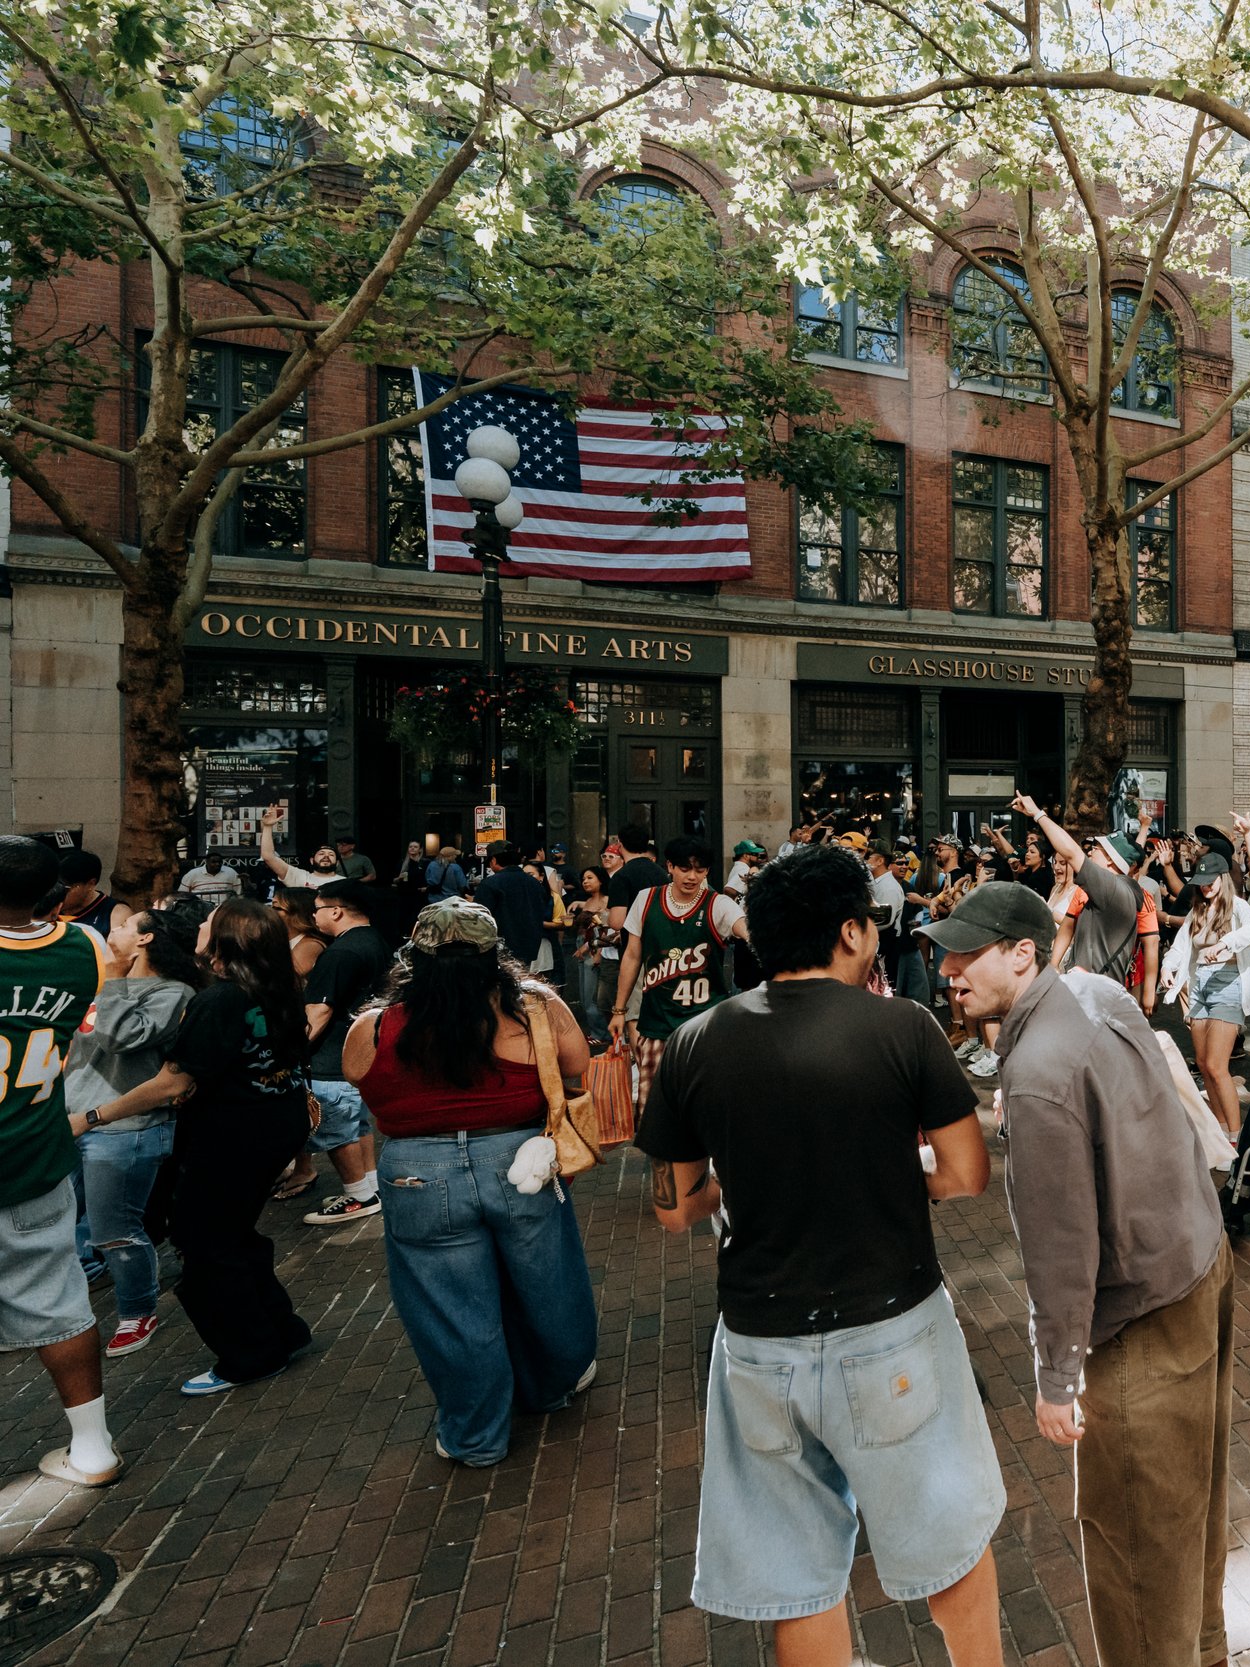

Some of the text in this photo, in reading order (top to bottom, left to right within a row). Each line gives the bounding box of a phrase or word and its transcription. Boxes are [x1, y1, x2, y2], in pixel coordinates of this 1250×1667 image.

[201, 612, 480, 649] OCCIDENTAL
[601, 637, 693, 662] ARTS
[868, 655, 1094, 686] GLASSHOUSE STU
[206, 764, 235, 772] things
[0, 985, 76, 1022] LEN
[672, 977, 710, 1006] 40
